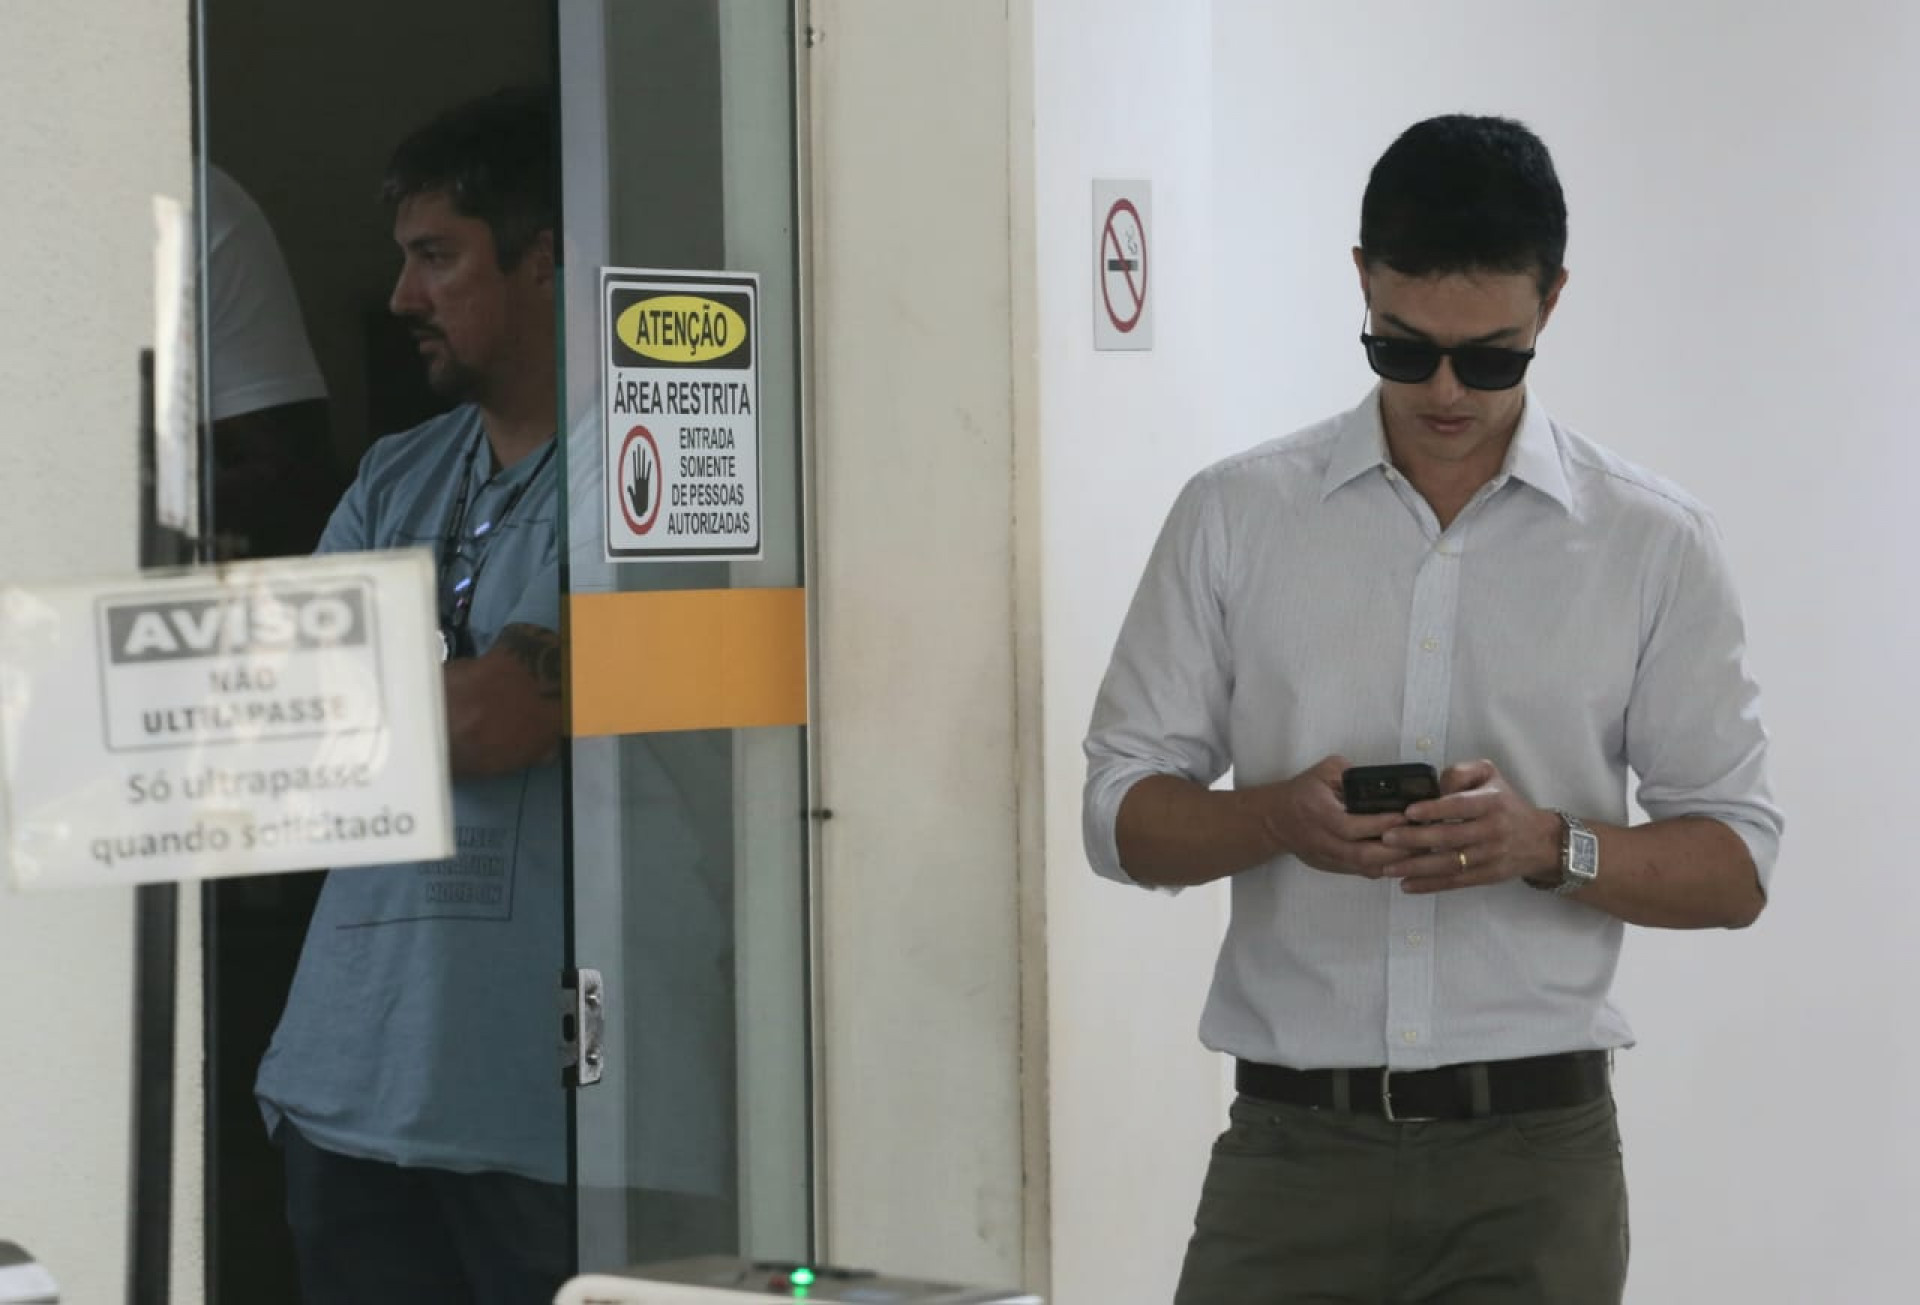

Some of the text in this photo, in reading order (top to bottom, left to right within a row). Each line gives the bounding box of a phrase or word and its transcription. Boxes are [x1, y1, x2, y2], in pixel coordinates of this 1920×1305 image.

[636, 303, 727, 355] ATENÇÃO
[614, 372, 751, 415] ÁREA RESTRITA
[680, 427, 735, 449] ENTRADA
[680, 456, 736, 478] SOMENTE
[671, 484, 744, 507] DE PESSOAS
[667, 512, 750, 535] AUTORIZADAS
[124, 597, 353, 655] AVISO
[209, 665, 277, 693] NÃO
[143, 695, 347, 734] ULTPASSE
[127, 768, 172, 804] Só
[90, 820, 231, 867] quando
